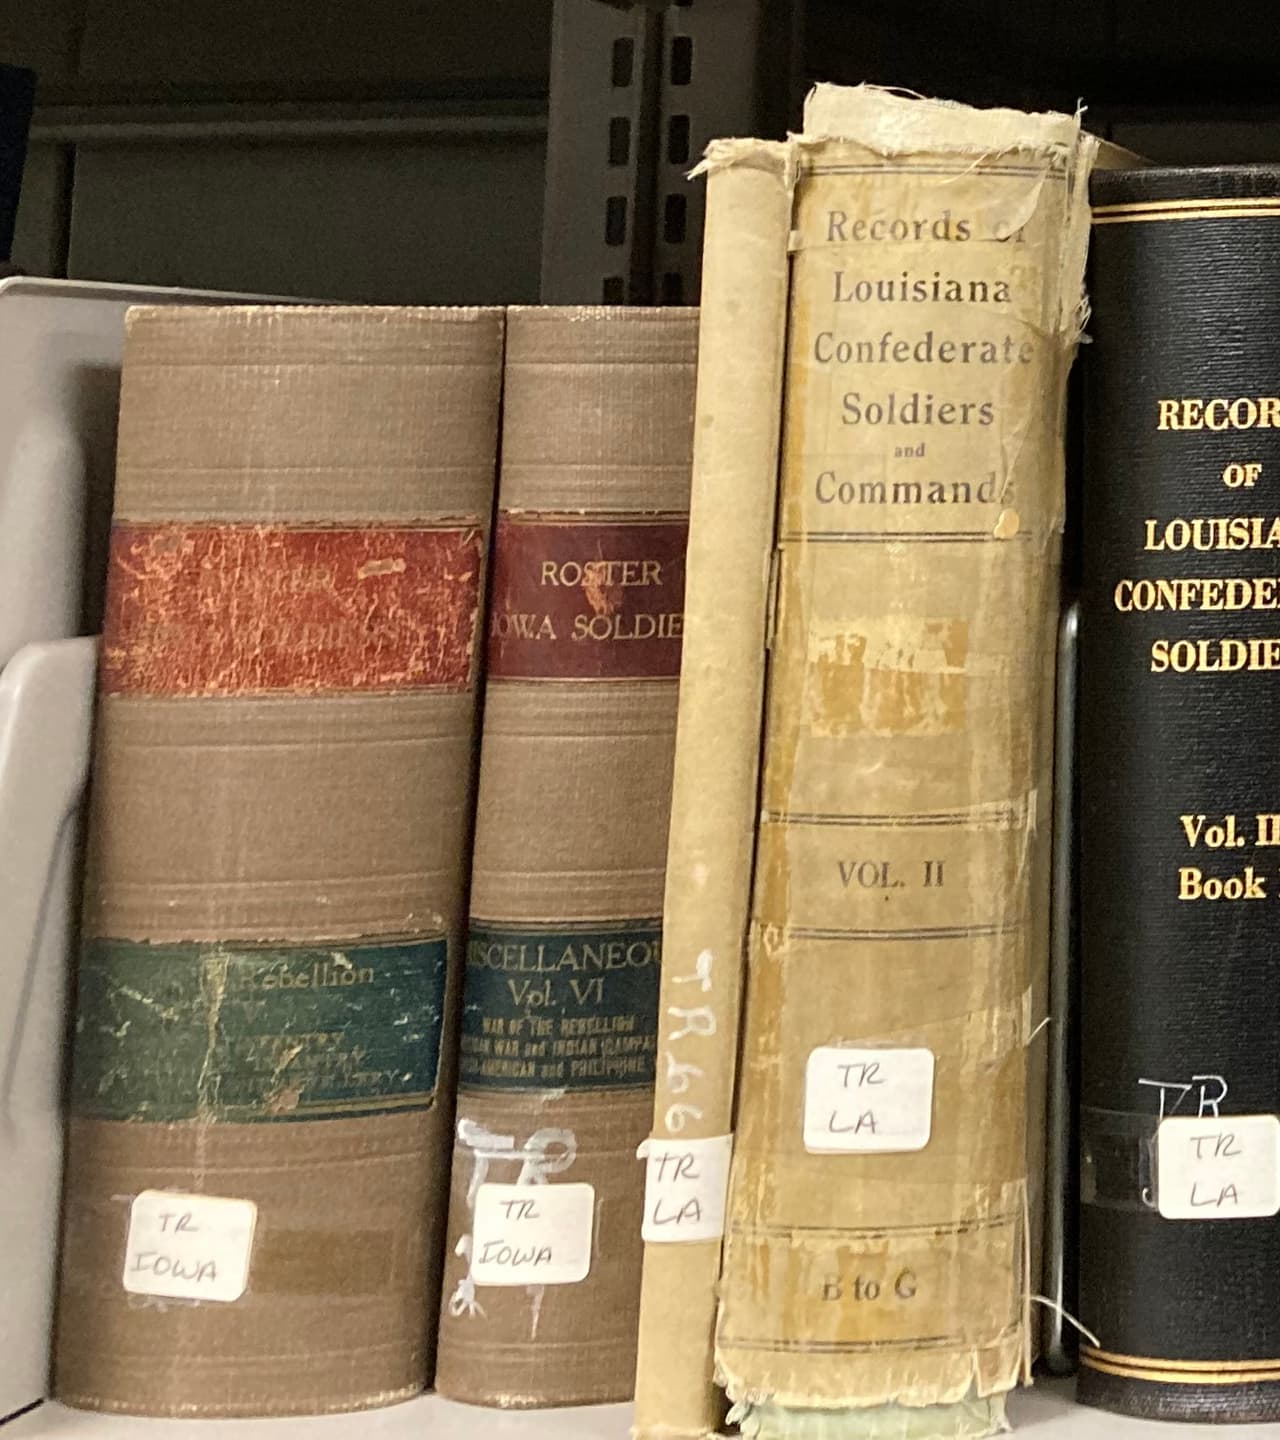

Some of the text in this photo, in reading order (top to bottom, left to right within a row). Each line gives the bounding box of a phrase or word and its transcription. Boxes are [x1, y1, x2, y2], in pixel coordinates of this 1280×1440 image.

[827, 210, 972, 242] Records
[833, 271, 1010, 303] Louisiana
[814, 332, 1035, 364] Confederate
[841, 393, 994, 426] Soldiers
[895, 443, 925, 458] and
[815, 471, 1015, 505] Commands
[1222, 463, 1263, 488] OF
[541, 560, 663, 587] ROSTER
[1180, 816, 1245, 847] Vol.
[838, 861, 945, 887] VOL. II
[1178, 868, 1267, 900] Book
[508, 979, 604, 1006] Vol. VI
[837, 1062, 888, 1088] TR
[828, 1110, 879, 1133] LA
[1190, 1133, 1242, 1158] TR
[657, 1154, 698, 1179] TR
[1190, 1184, 1239, 1207] LA
[159, 1212, 200, 1232] TR
[500, 1200, 539, 1220] TR
[654, 1199, 701, 1224] LA
[135, 1253, 217, 1282] IOWA
[479, 1243, 552, 1266] IOWA
[854, 1271, 880, 1298] to
[895, 1271, 916, 1297] G
